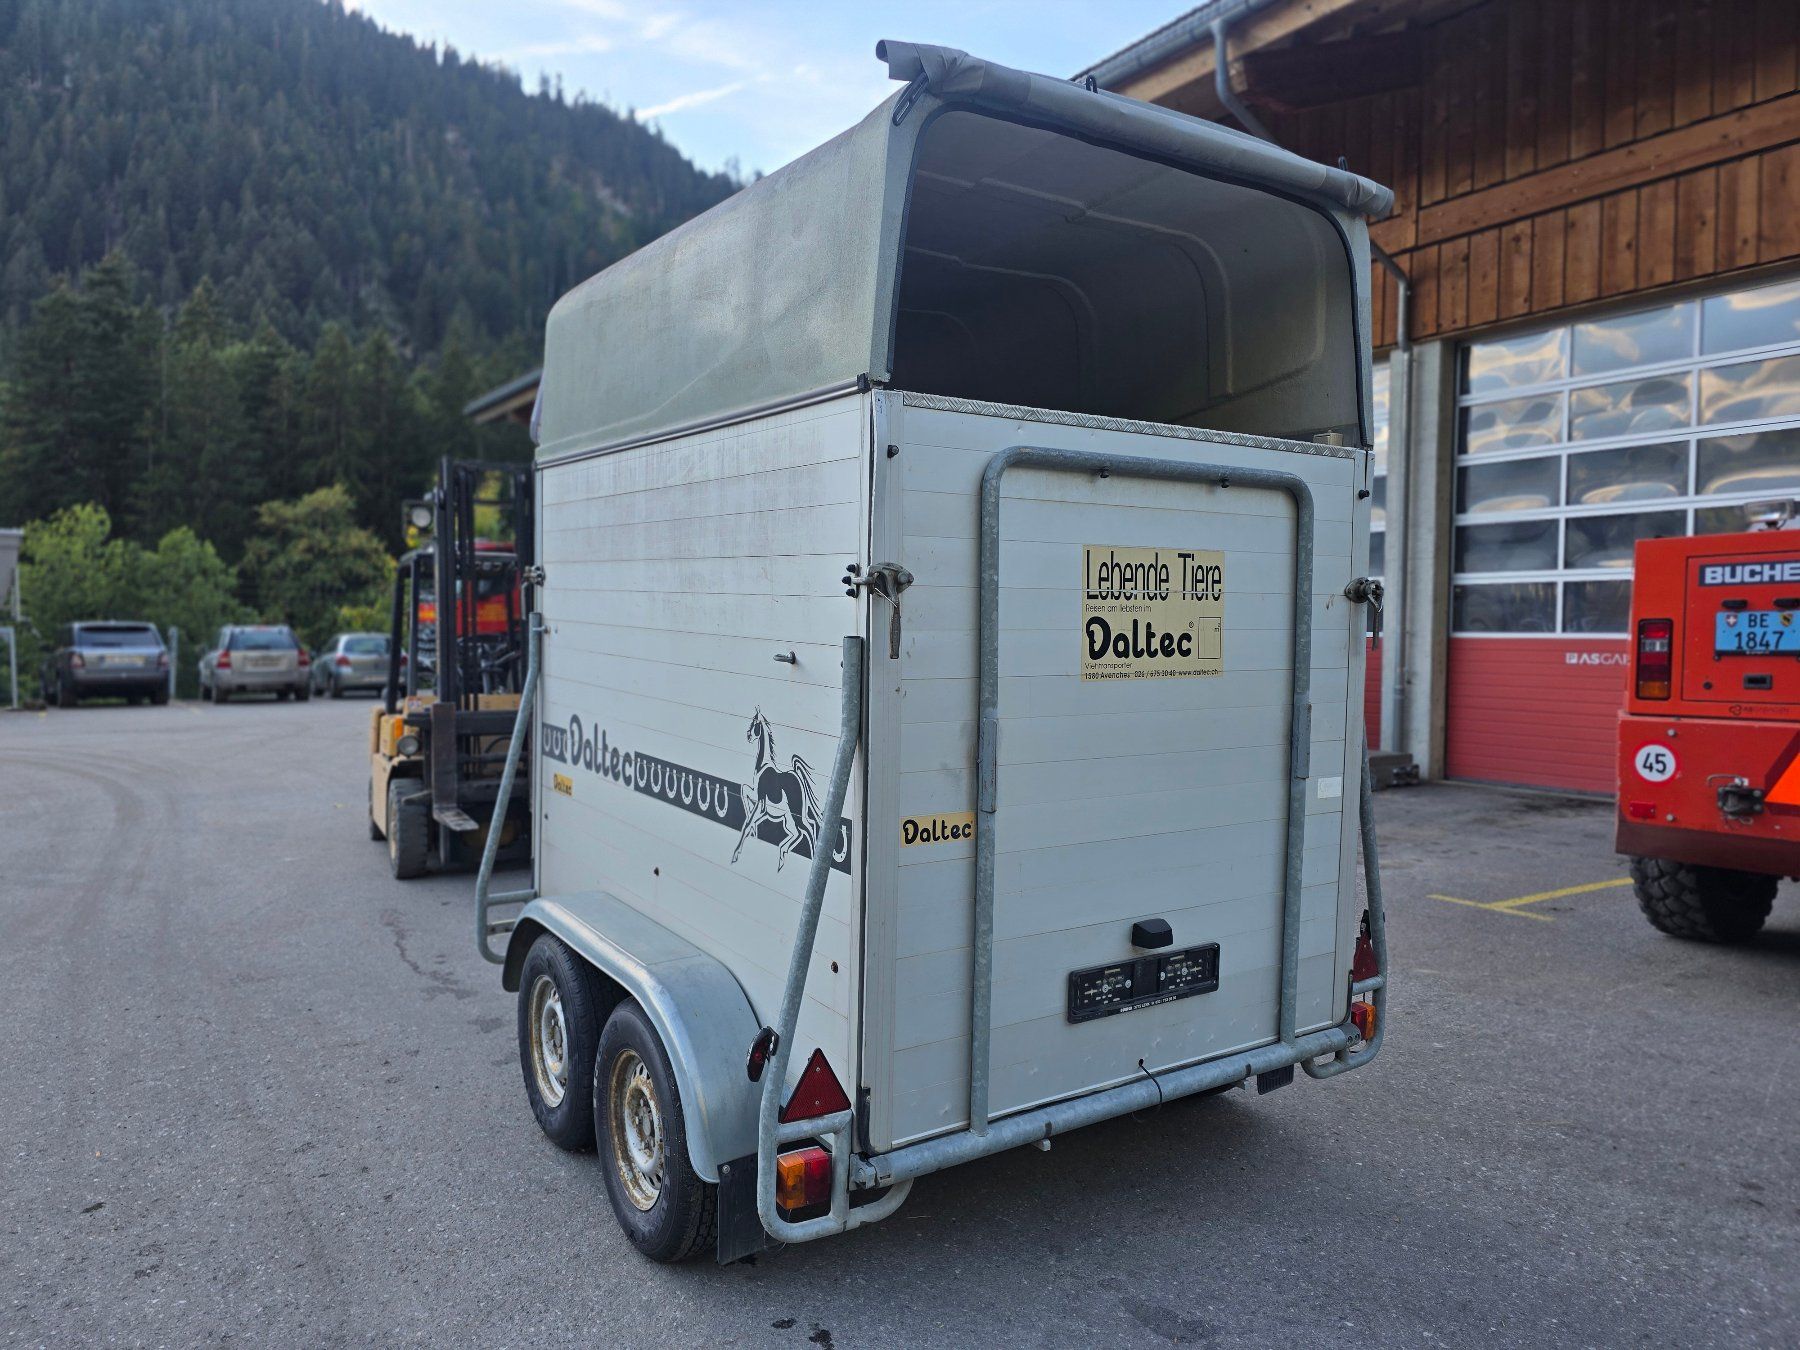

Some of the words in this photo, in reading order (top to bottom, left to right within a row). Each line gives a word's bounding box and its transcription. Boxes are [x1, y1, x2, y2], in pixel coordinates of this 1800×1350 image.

[1086, 550, 1170, 601] Lebende
[1177, 552, 1222, 601] Tiere
[1748, 613, 1769, 628] BE
[1085, 616, 1193, 661] Daltec
[1734, 631, 1785, 650] 1847
[569, 713, 633, 788] Daltec
[1642, 752, 1668, 775] 45
[902, 818, 972, 845] Daltec
